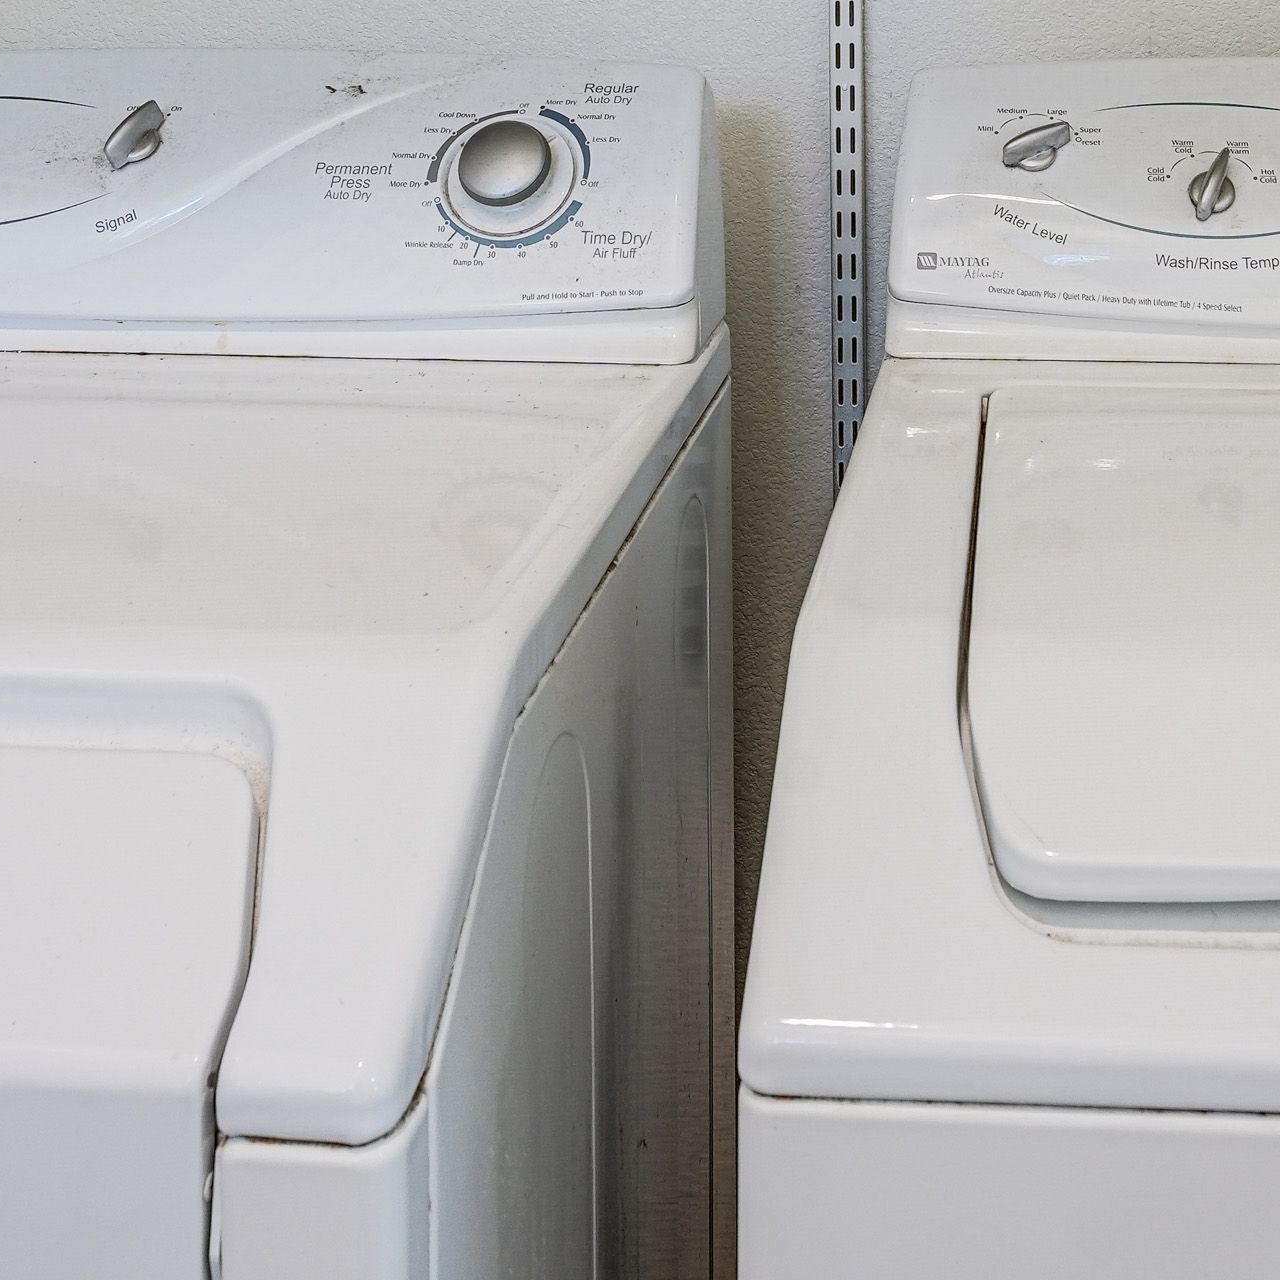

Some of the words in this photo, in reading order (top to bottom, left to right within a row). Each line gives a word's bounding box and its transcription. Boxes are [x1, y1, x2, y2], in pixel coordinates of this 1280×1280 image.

[583, 83, 640, 96] Regular
[565, 99, 578, 107] Dry
[585, 96, 610, 104] Auto
[613, 96, 633, 106] Dry
[438, 111, 455, 119] Cool
[455, 111, 477, 119] Down
[1047, 108, 1068, 116] Large
[423, 126, 439, 134] Less
[440, 127, 453, 135] Dry
[1079, 126, 1102, 134] Super
[608, 136, 621, 144] Dry
[391, 152, 418, 160] Normal
[418, 152, 430, 161] Dry
[315, 162, 393, 175] Permanent
[330, 175, 371, 189] Press
[389, 180, 408, 188] More
[409, 180, 422, 190] Dry
[588, 180, 599, 188] Off
[324, 190, 350, 200] Auto
[352, 190, 372, 202] Dry
[95, 209, 138, 233] Signal
[575, 220, 584, 228] 60
[993, 204, 1030, 231] Water
[1031, 222, 1068, 245] Level
[437, 225, 446, 233] 10
[581, 230, 617, 245] Time
[621, 230, 653, 249] Dry/
[404, 240, 428, 249] Wrinkle
[429, 241, 454, 249] Release
[459, 242, 468, 250] 20
[549, 241, 559, 249] 50
[487, 251, 496, 259] 30
[517, 250, 527, 258] 40
[592, 248, 609, 259] Air
[612, 248, 638, 259] Fluff
[452, 258, 472, 267] Damp
[473, 259, 485, 267] Dry
[939, 256, 990, 267] MAYTAG
[1155, 254, 1238, 271] Wash/Rinse
[1241, 255, 1280, 269] Temp
[964, 269, 1004, 280] Atlantis
[522, 293, 535, 301] Pull
[536, 293, 550, 301] and
[551, 292, 568, 300] Hold
[578, 291, 595, 299] Start
[600, 290, 617, 298] Push
[628, 288, 644, 297] Stop
[988, 285, 1015, 295] Oversize
[1016, 287, 1041, 298] Capacity
[1043, 290, 1057, 299] Plus
[1062, 291, 1080, 301] Quiet
[1081, 293, 1096, 302] Pack
[1102, 295, 1120, 304] Heavy
[1122, 296, 1137, 305] Duty
[1138, 297, 1152, 306] with
[1153, 298, 1178, 308] Lifetime
[1180, 300, 1191, 309] Tub
[1202, 301, 1222, 311] Speed
[1223, 303, 1243, 313] Select
